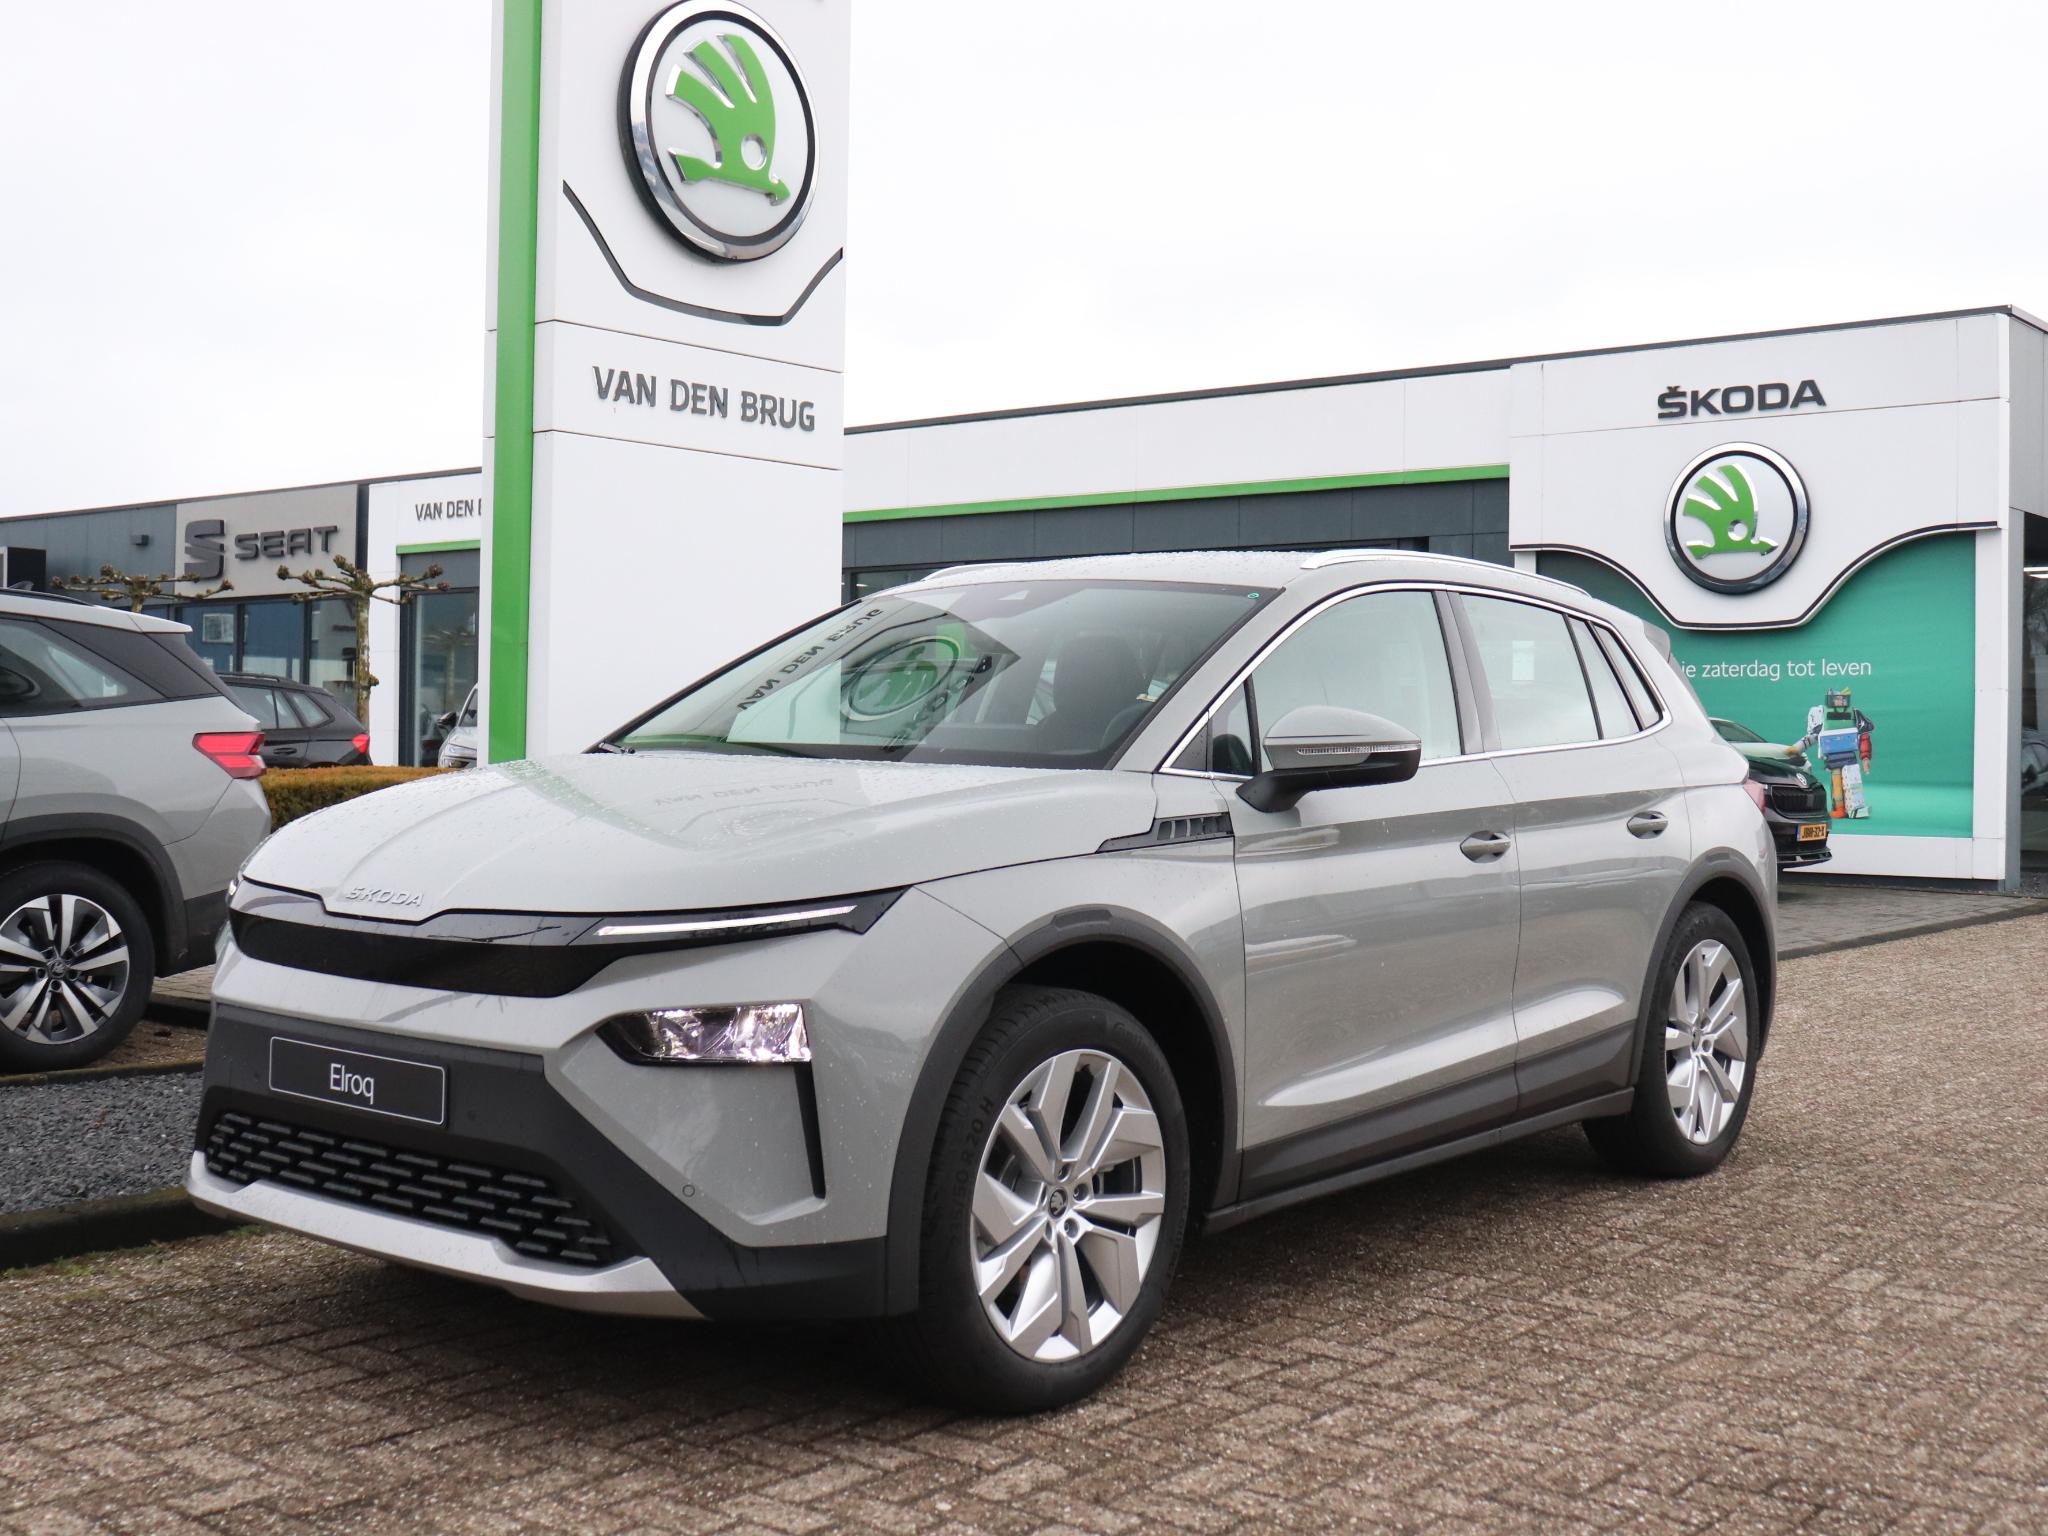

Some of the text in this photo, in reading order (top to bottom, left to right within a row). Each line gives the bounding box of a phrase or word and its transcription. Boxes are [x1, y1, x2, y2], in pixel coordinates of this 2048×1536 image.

[591, 365, 816, 432] VAN DEN BRUG
[1657, 379, 1827, 419] ŠKODA
[415, 502, 442, 521] VAN
[446, 499, 474, 519] DEN
[234, 525, 338, 561] SEAT
[1701, 659, 1781, 682] zaterdag
[1786, 659, 1816, 677] tot
[1821, 658, 1872, 676] leven
[330, 1063, 374, 1105] Elroq
